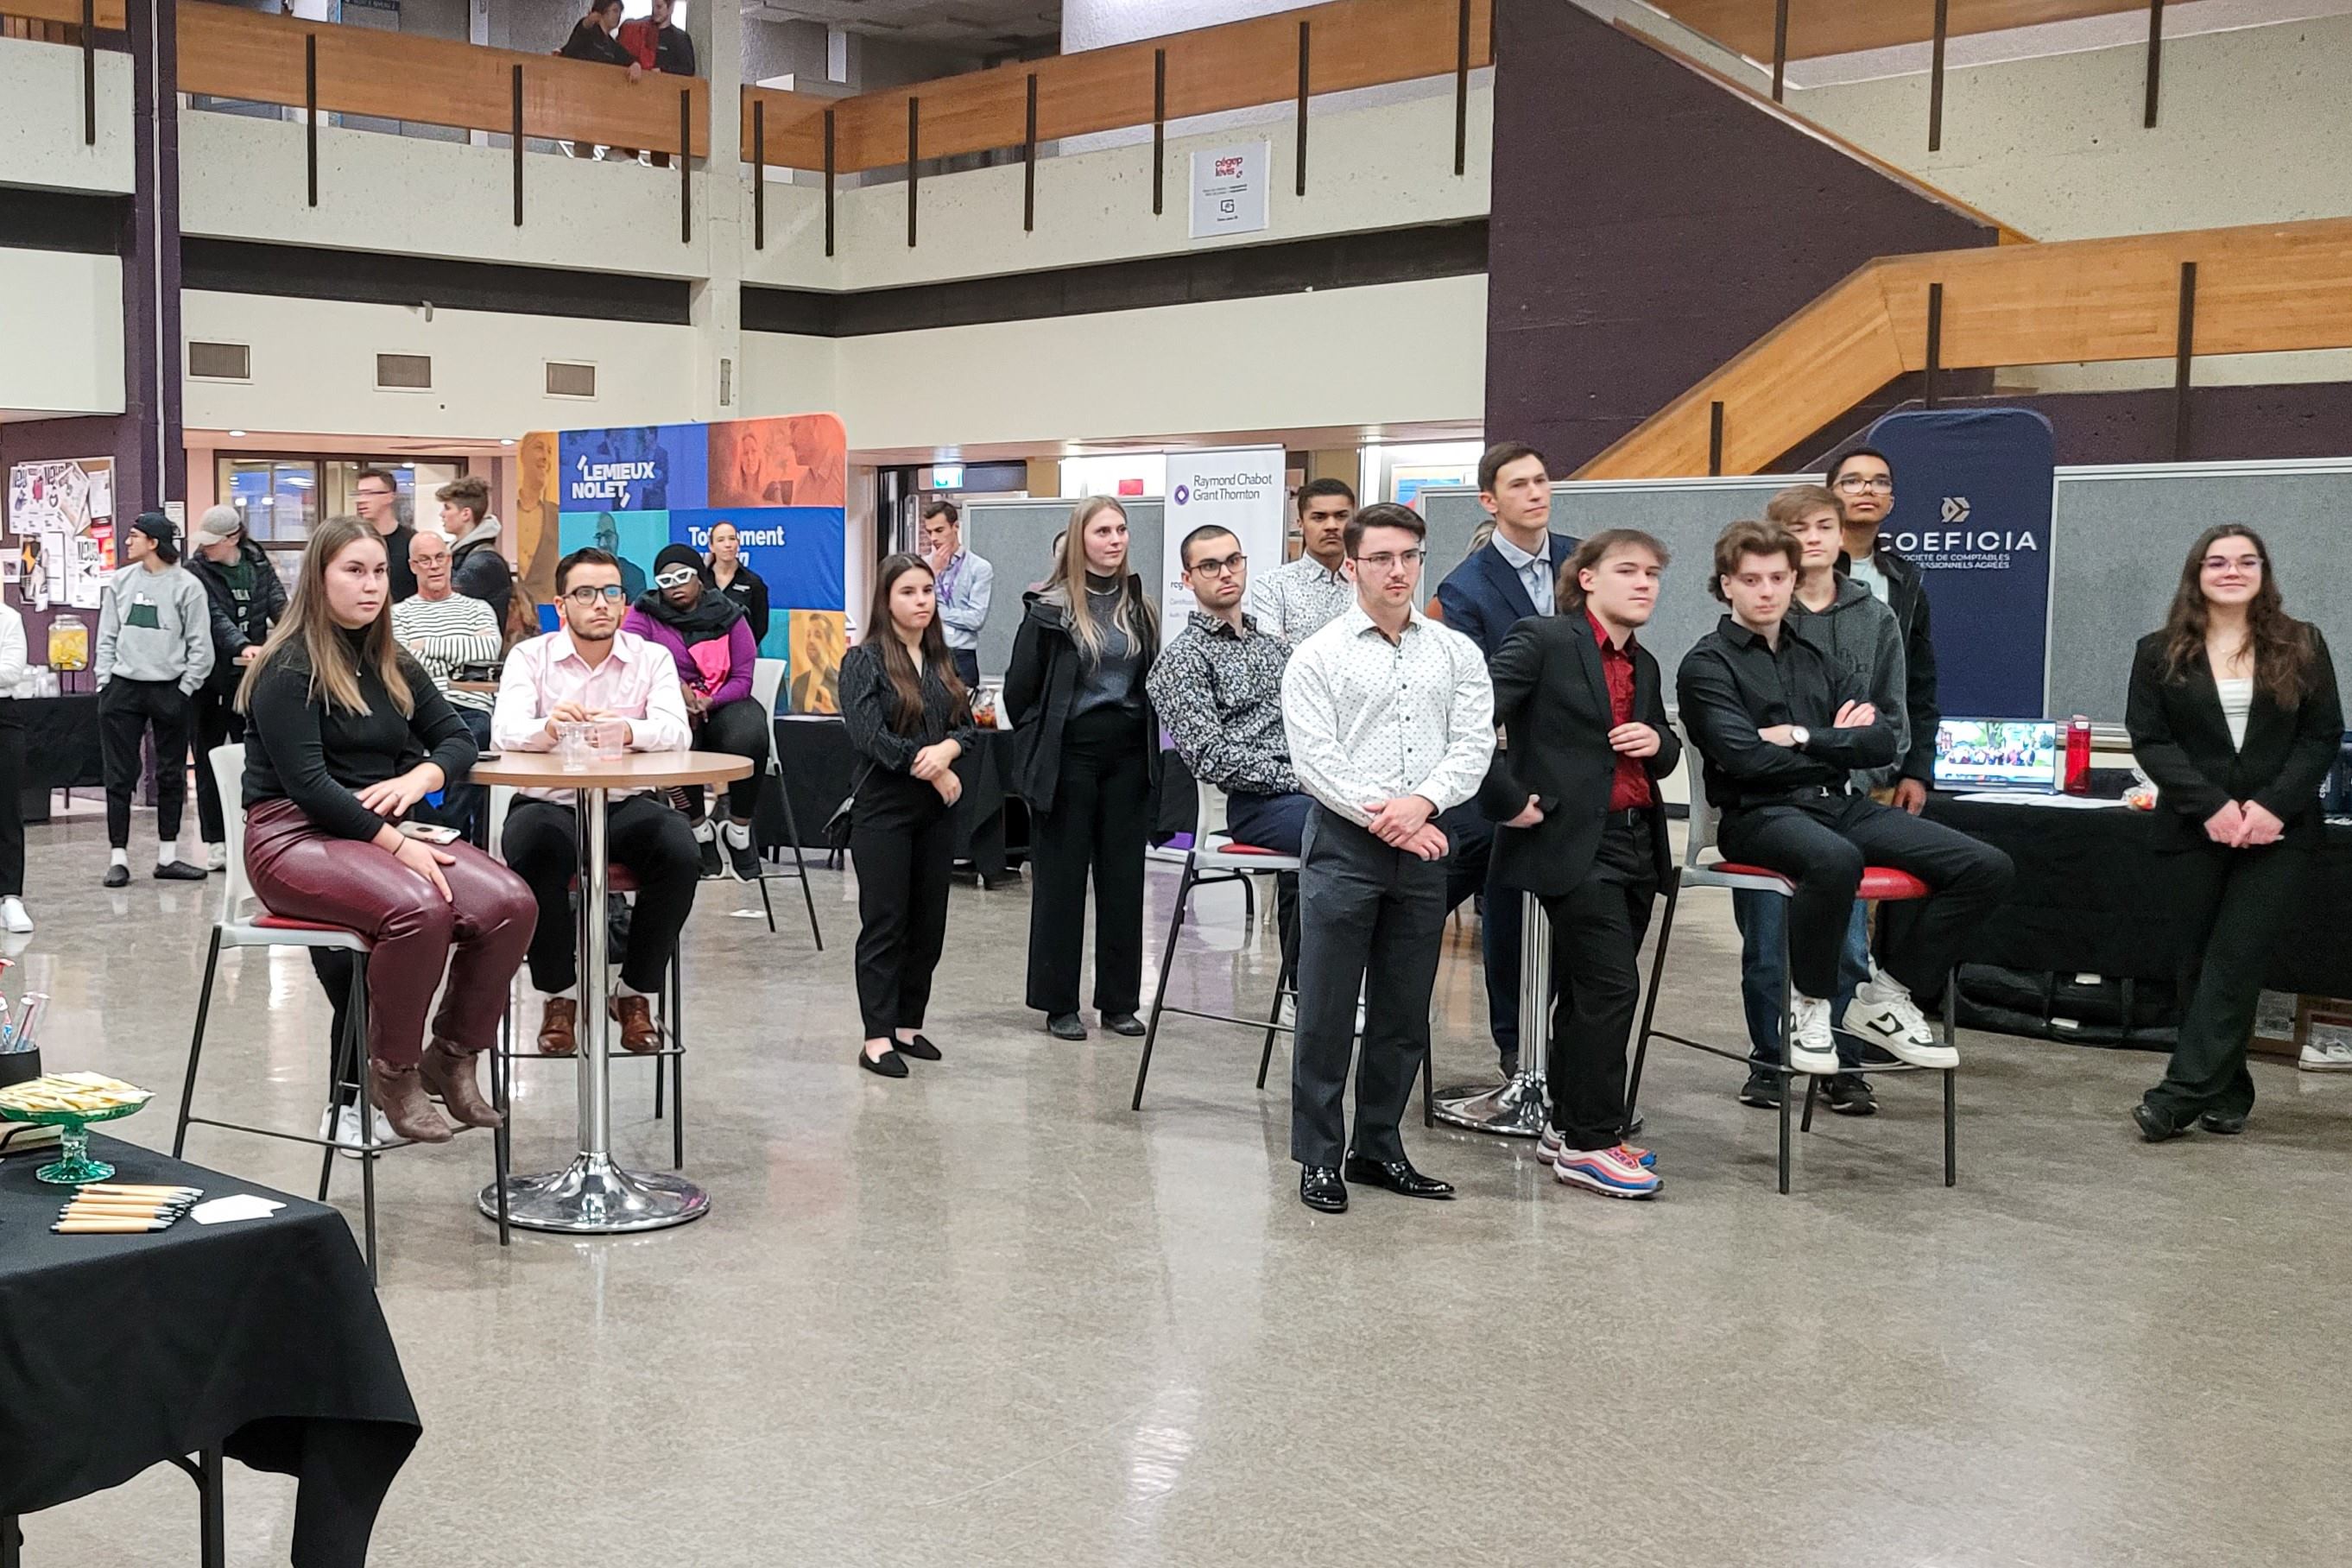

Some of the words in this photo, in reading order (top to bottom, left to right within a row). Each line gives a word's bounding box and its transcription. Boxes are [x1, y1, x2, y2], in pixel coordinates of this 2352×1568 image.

[1193, 474, 1236, 489] Raymond
[1237, 473, 1272, 485] Chabot
[1193, 489, 1218, 501] Grant
[1220, 488, 1260, 501] Thornton
[1877, 531, 2038, 552] COEFICIA
